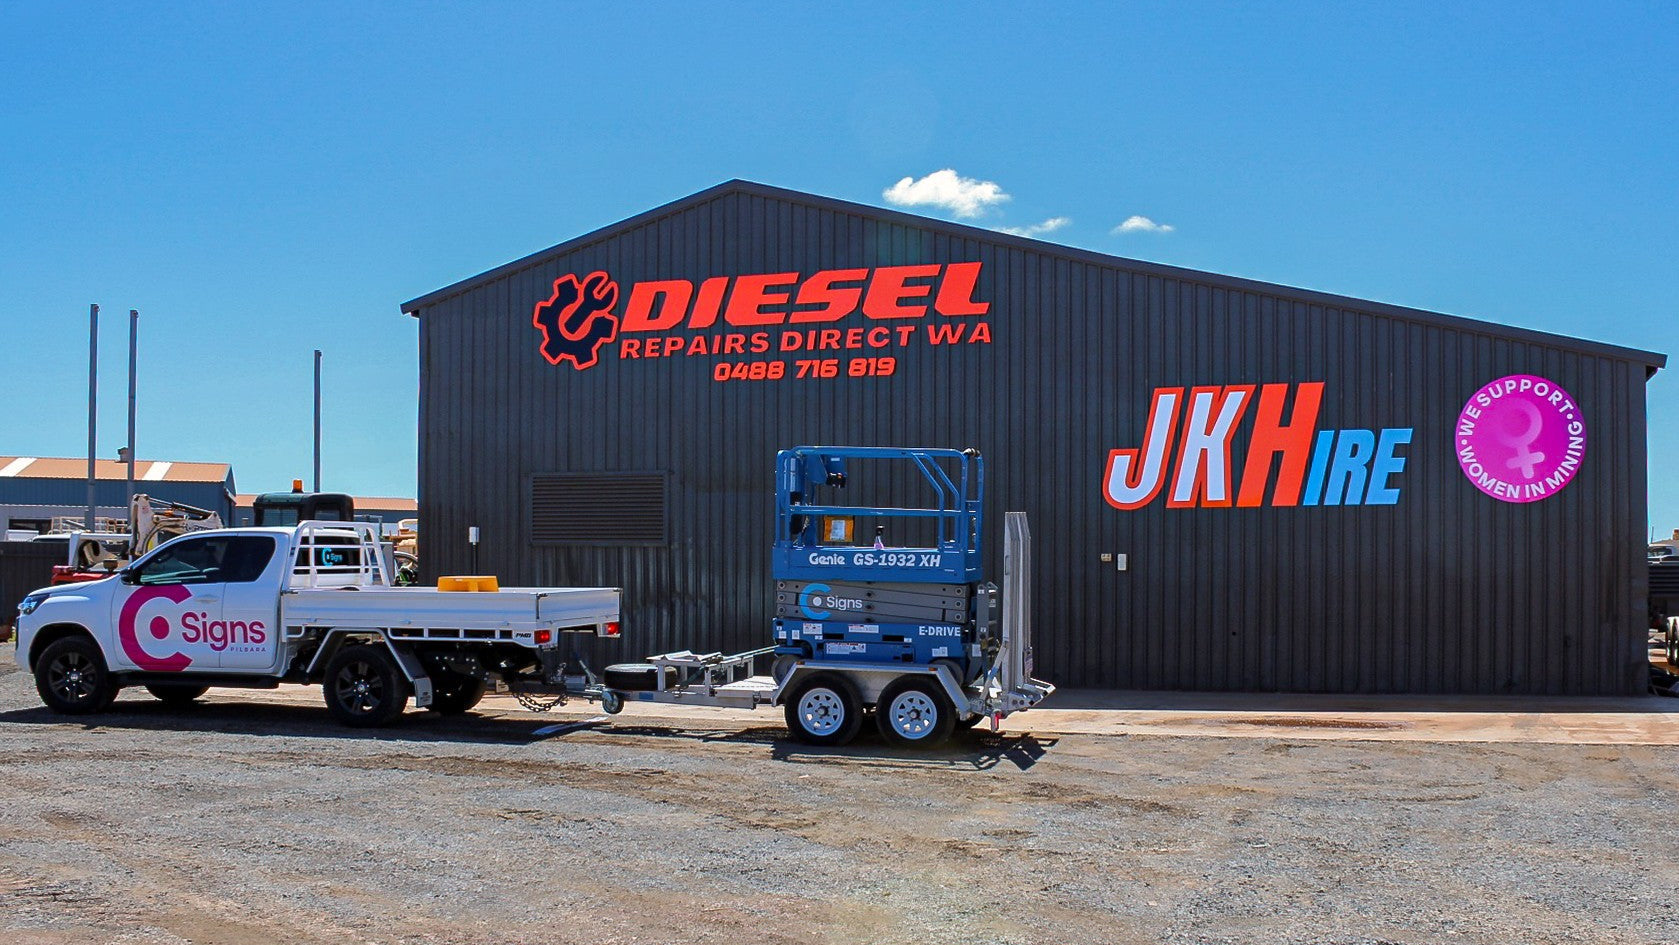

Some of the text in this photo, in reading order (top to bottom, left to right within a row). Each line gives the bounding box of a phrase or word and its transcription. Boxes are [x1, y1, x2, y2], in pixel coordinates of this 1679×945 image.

[619, 261, 991, 332] DIESEL
[619, 322, 991, 359] REPAIRS DIRECT WA
[713, 357, 896, 381] 0488 716 819
[1458, 378, 1574, 436] WE SUPPORT
[1460, 420, 1584, 499] WOMEN IN MINING
[808, 552, 942, 567] Genie GS-1932 XH
[826, 595, 864, 611] Signs
[181, 611, 266, 652] Signs
